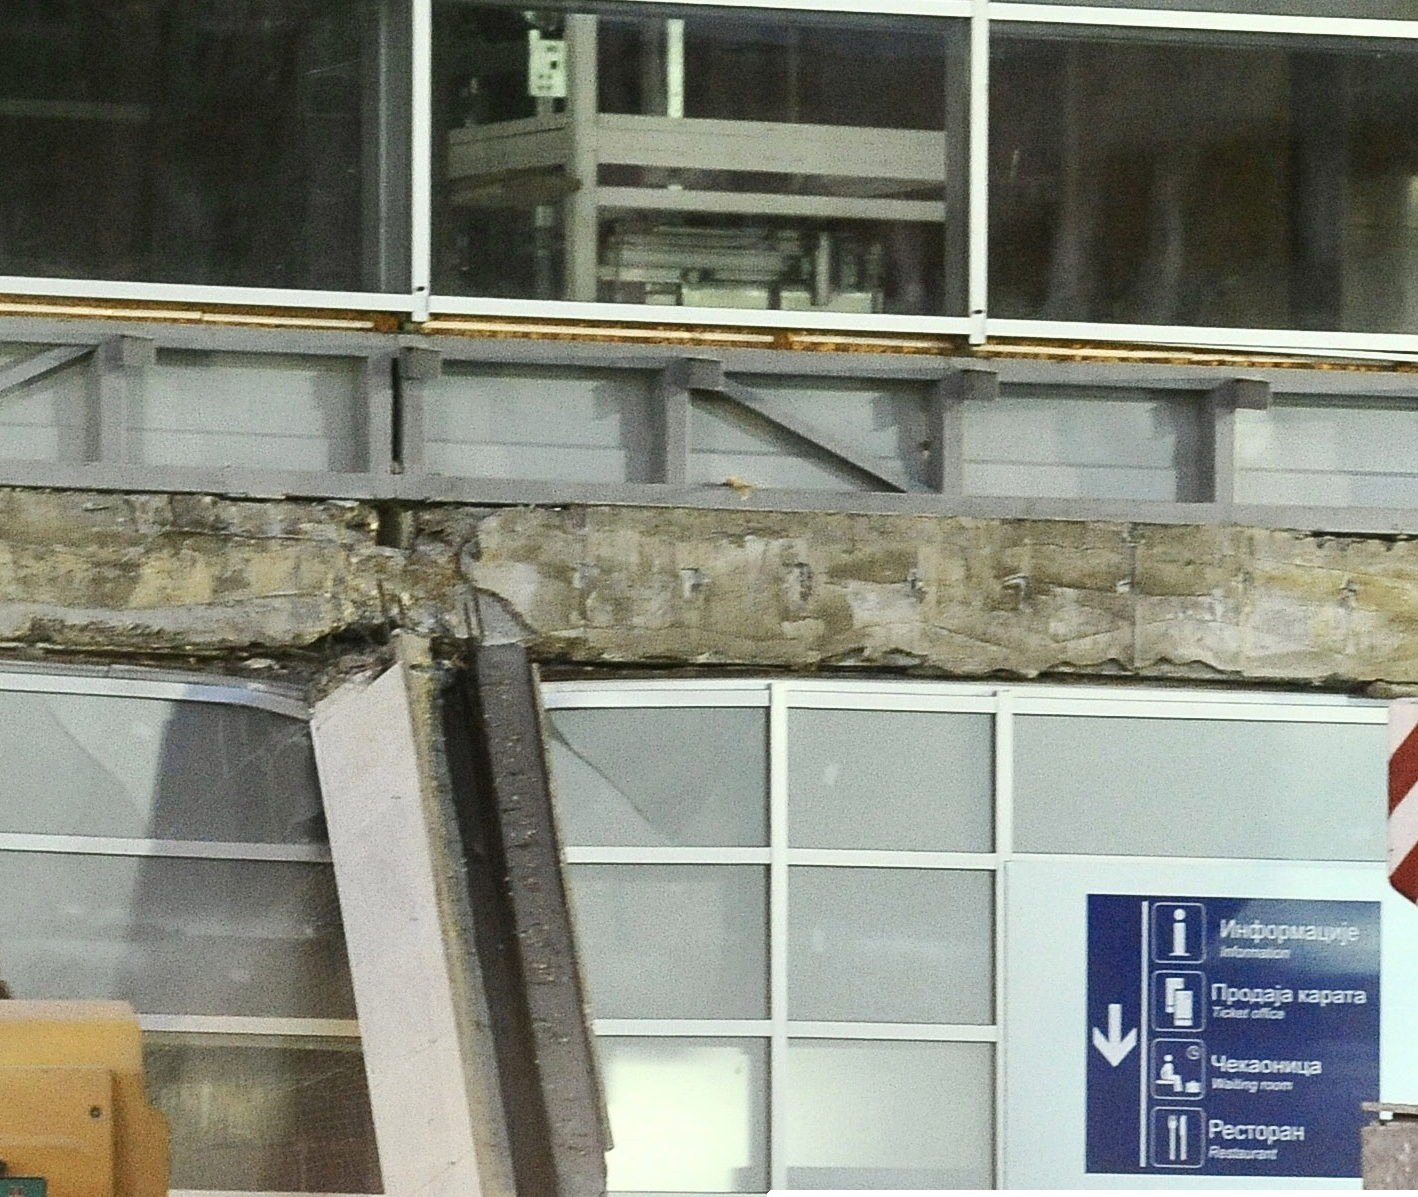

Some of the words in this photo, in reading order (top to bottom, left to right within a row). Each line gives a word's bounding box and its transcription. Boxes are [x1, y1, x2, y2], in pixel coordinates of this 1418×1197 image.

[1219, 919, 1360, 945] Информације
[1219, 945, 1292, 959] Information
[1211, 983, 1294, 1006] Продаја
[1297, 989, 1367, 1006] карата
[1212, 1007, 1249, 1019] Ticket
[1251, 1008, 1286, 1020] office
[1210, 1054, 1323, 1076] Чекаоница
[1211, 1078, 1259, 1093] Waiting
[1259, 1081, 1294, 1091] room
[1208, 1119, 1305, 1144] Ресторан
[1208, 1146, 1279, 1160] Restaurant
